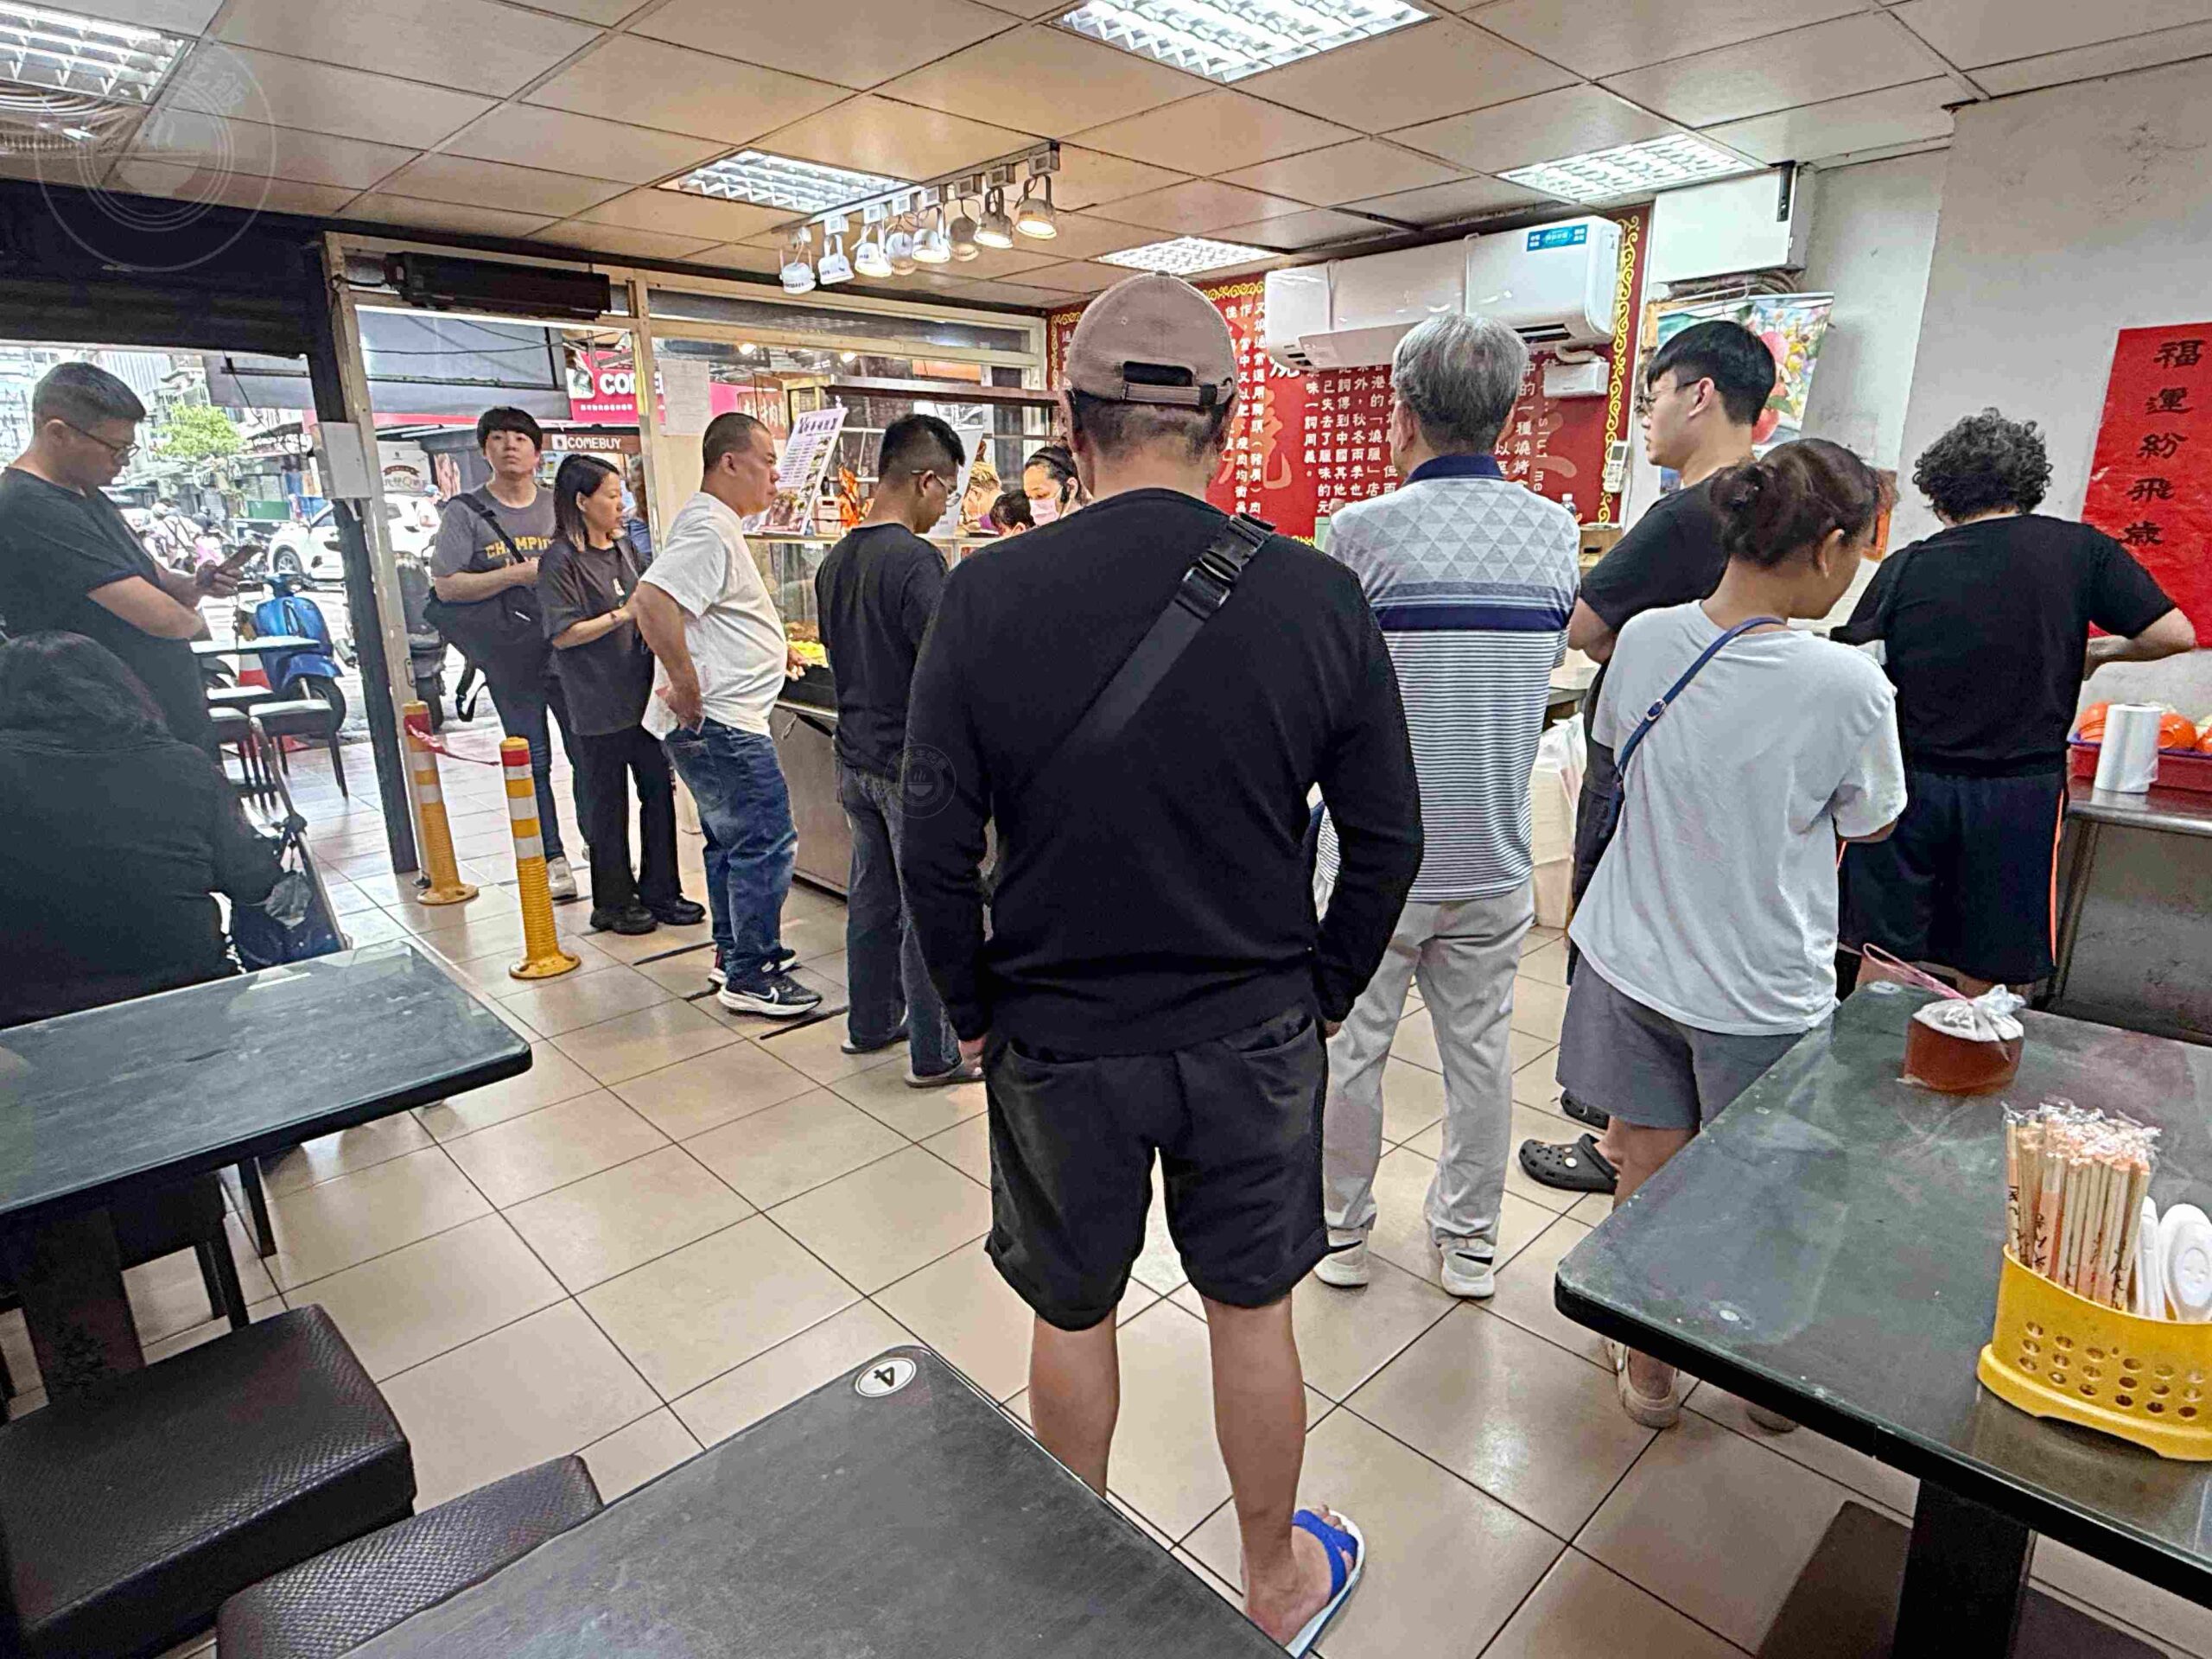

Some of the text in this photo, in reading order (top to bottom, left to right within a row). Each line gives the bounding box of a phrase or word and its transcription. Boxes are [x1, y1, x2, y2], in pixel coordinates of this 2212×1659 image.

[568, 436, 622, 450] COMEBUY
[1303, 373, 1319, 478] 味一詞同義。
[1513, 363, 1536, 484] 中的一種燒烤
[2117, 338, 2207, 546] 福運紛飛歲
[874, 1366, 895, 1388] 4
